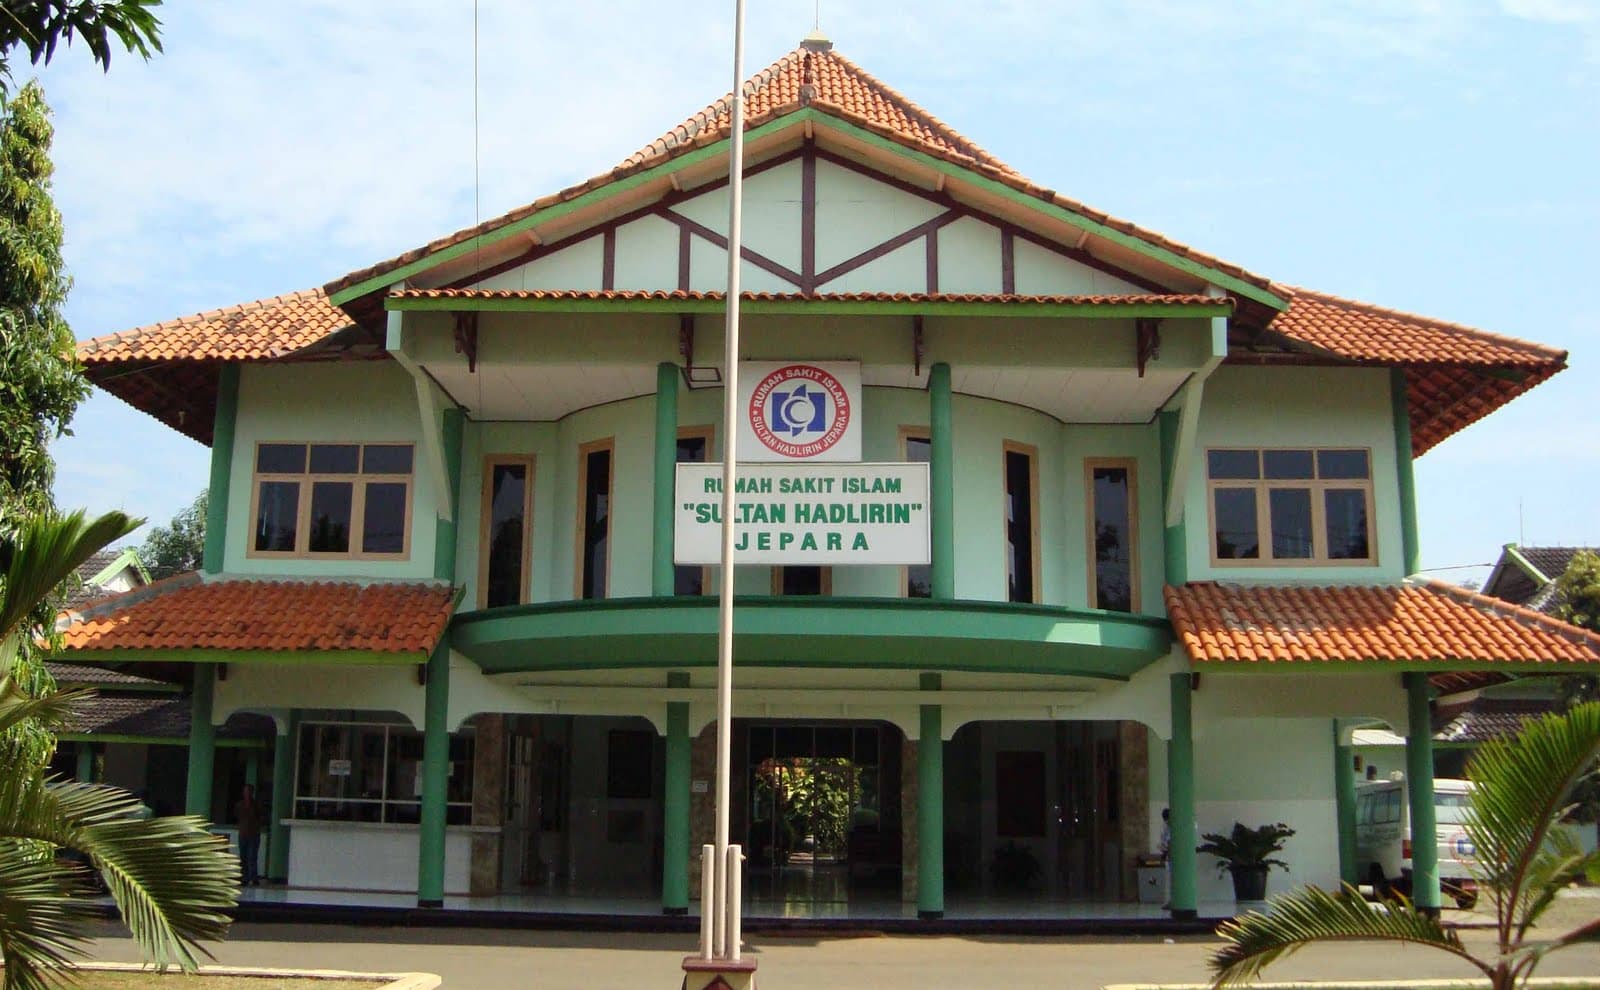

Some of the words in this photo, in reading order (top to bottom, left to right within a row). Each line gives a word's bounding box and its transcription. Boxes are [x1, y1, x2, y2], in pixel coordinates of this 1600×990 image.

[754, 373, 784, 408] RUMAH
[785, 368, 822, 380] SAKIT
[822, 377, 846, 408] ISLAM
[753, 415, 778, 448] SULTAN
[776, 441, 822, 455] HADLIRIN
[823, 416, 847, 448] JEPARA
[779, 477, 835, 493] SAKIT
[842, 477, 901, 493] ISLAM
[794, 503, 922, 523] HADLIRIN"
[735, 532, 869, 551] JEPARA
